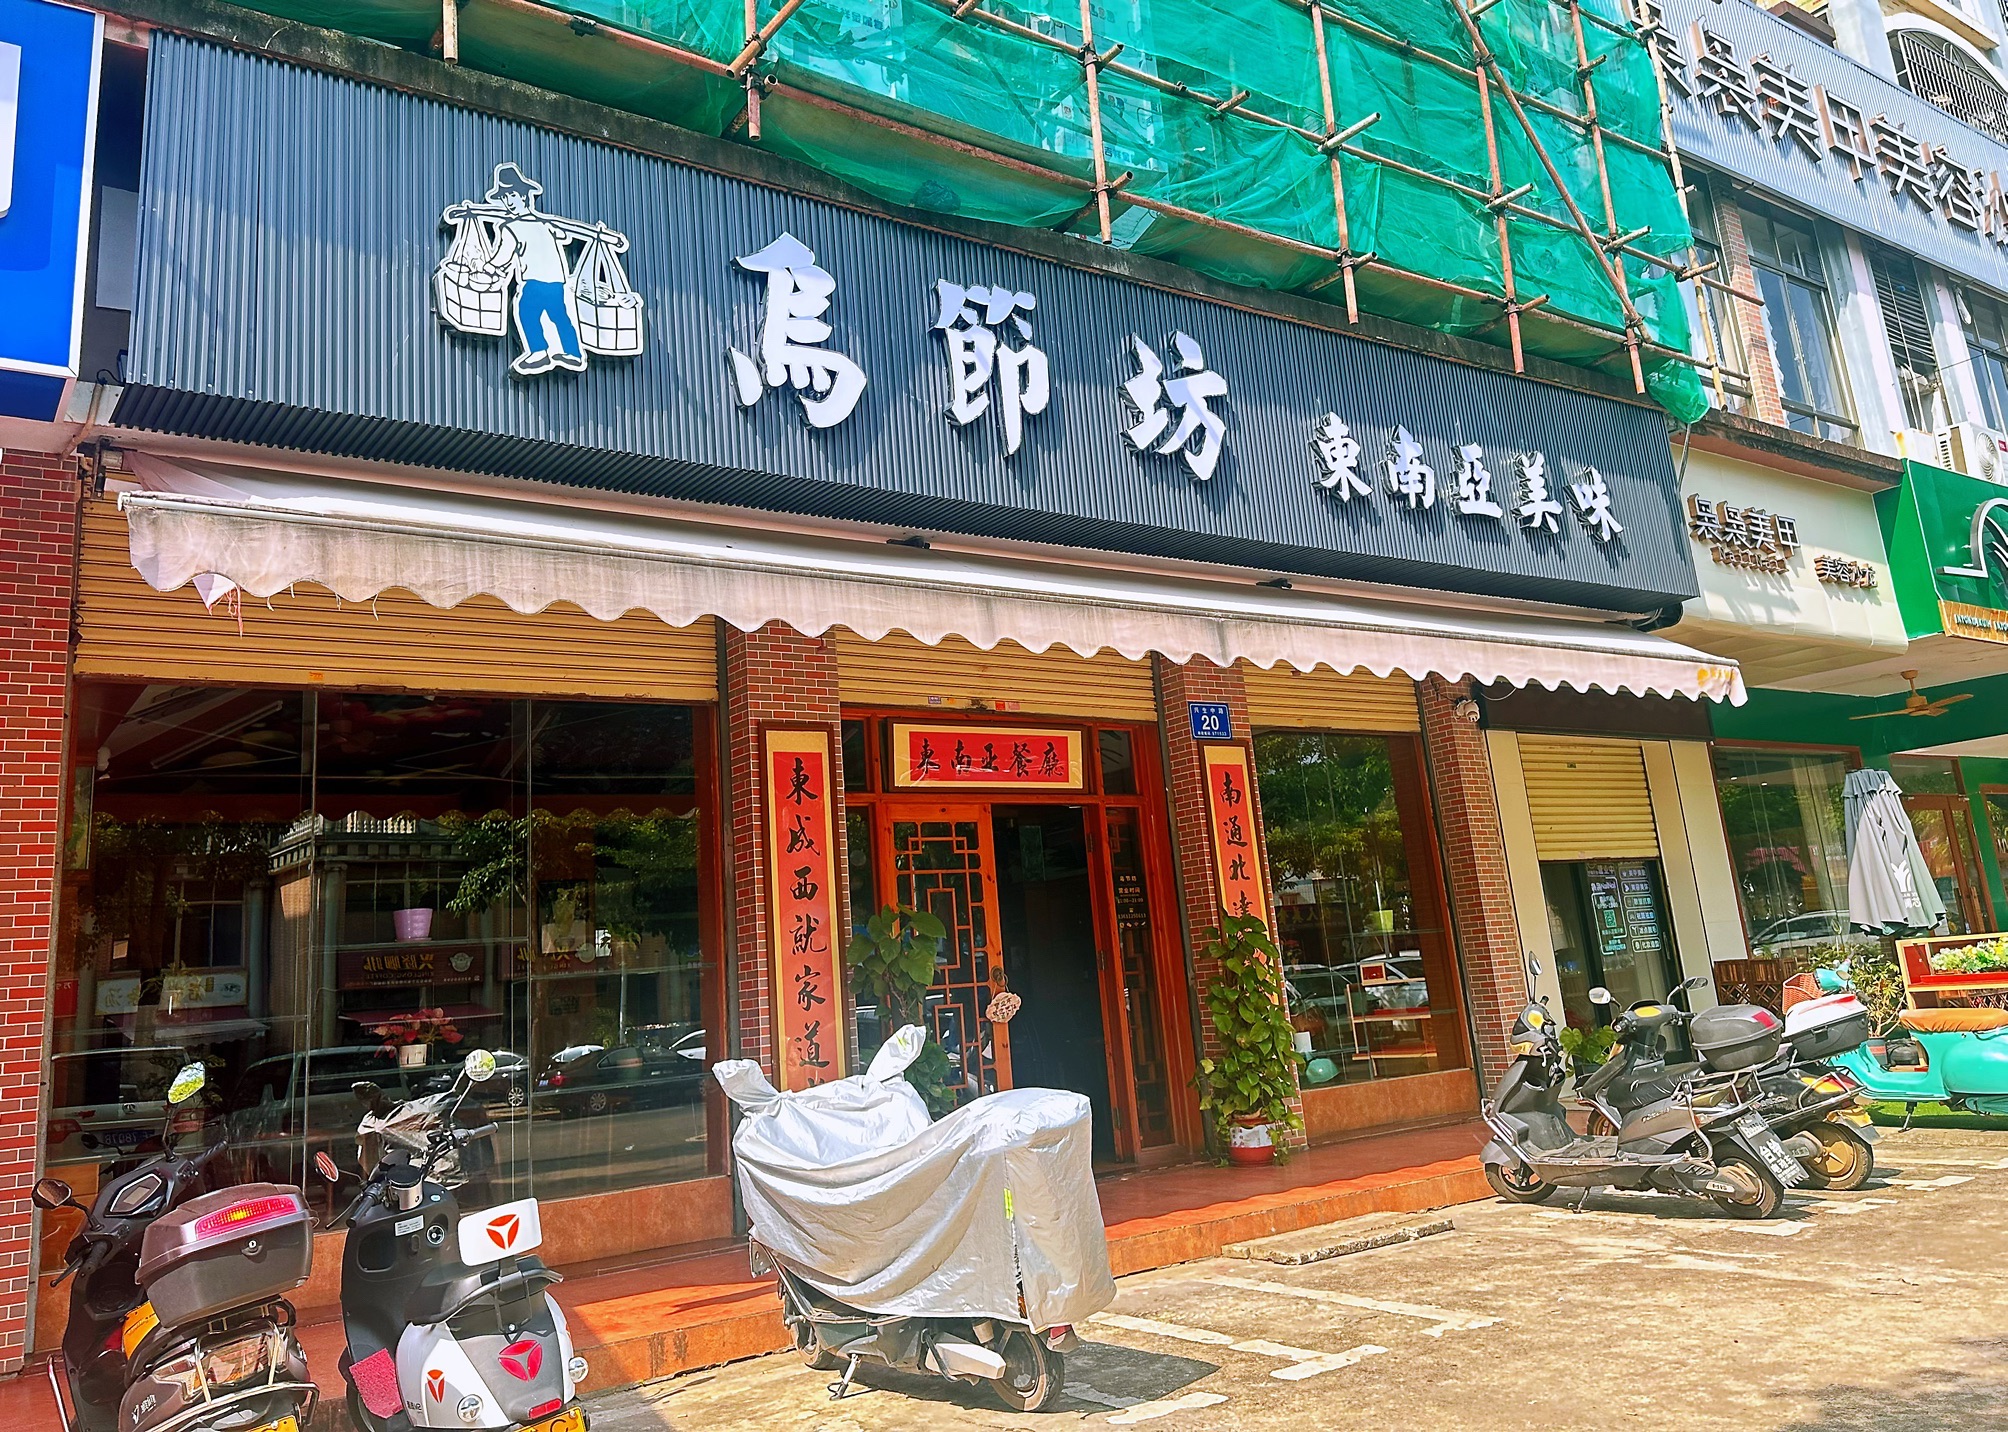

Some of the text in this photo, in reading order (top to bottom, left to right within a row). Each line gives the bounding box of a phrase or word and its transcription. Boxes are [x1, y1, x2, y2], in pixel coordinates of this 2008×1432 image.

[1309, 411, 1624, 543] 東南亞美味
[1201, 714, 1220, 731] 20
